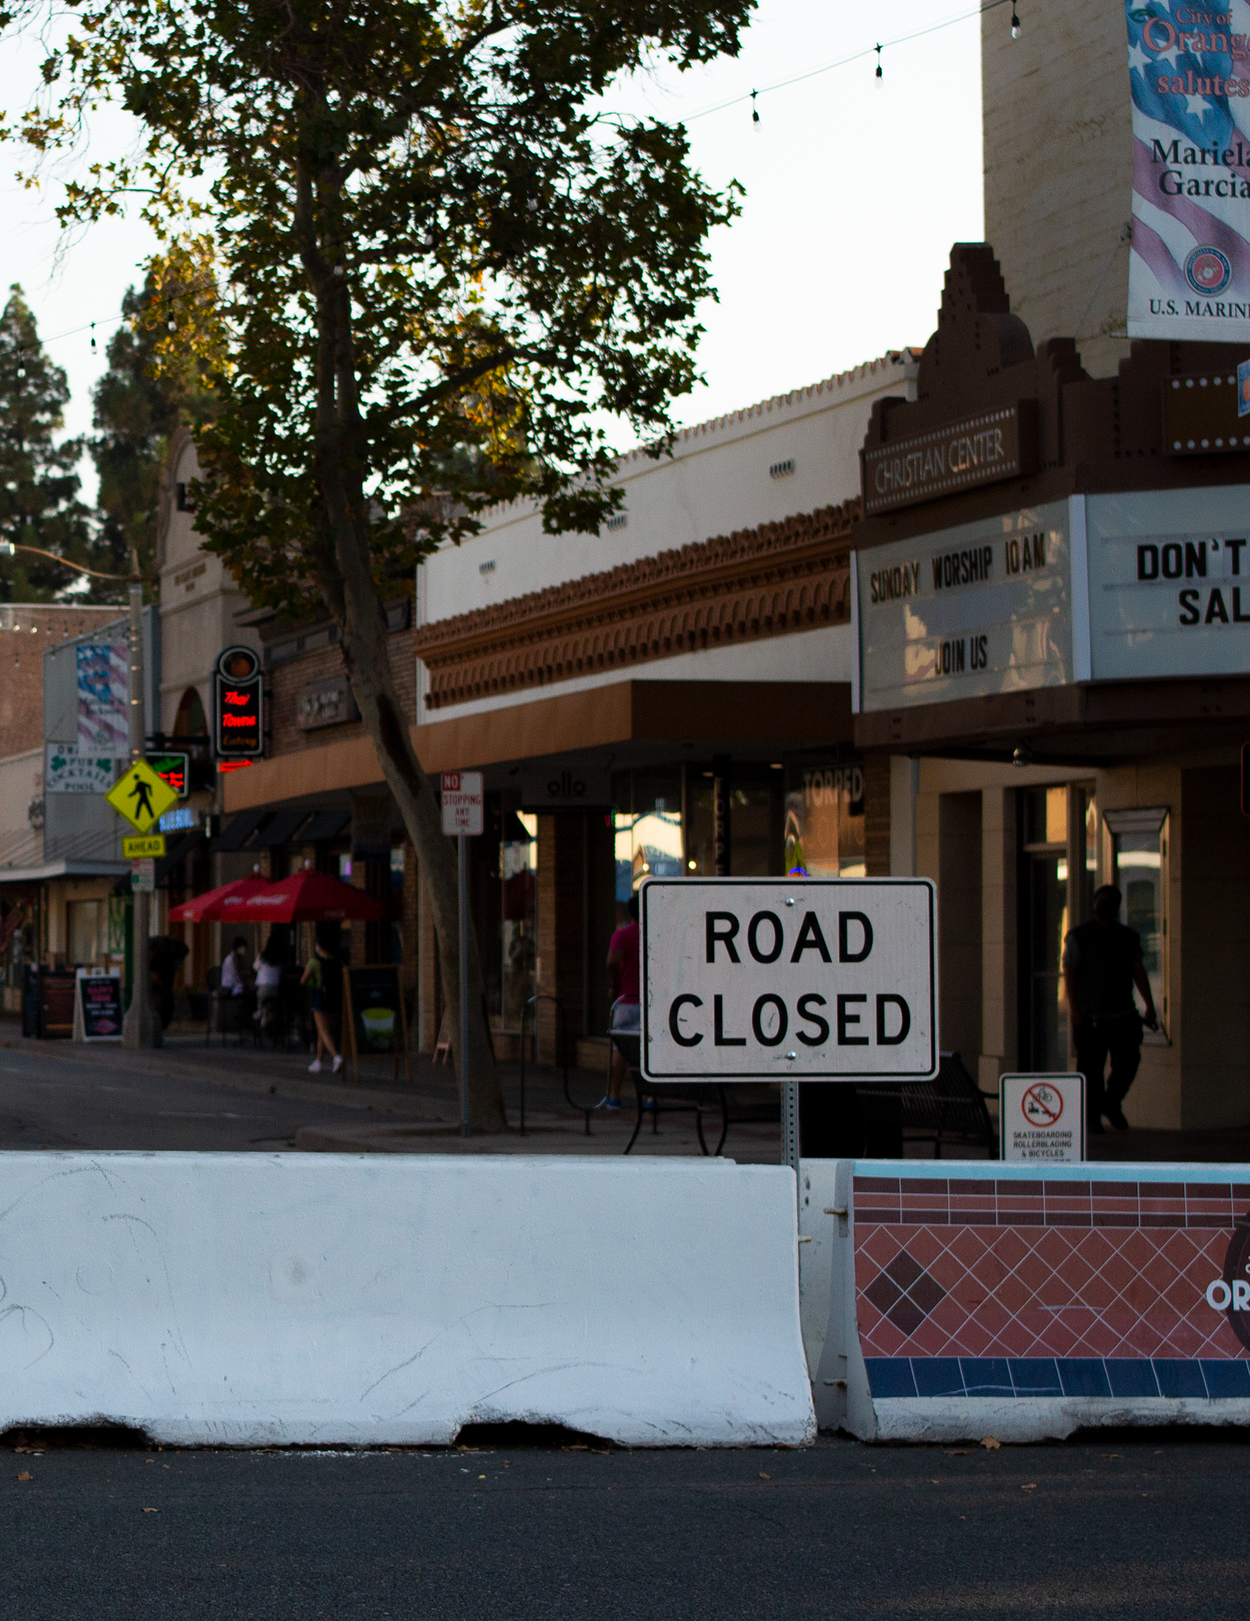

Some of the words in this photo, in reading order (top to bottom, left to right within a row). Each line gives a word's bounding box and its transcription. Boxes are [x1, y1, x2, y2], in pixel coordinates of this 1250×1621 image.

[1176, 7, 1212, 29] City
[1216, 8, 1233, 26] of
[1157, 69, 1250, 98] salutes
[1159, 170, 1250, 198] Garcia
[1149, 299, 1179, 316] U.S.
[875, 444, 945, 494] CHRISTIAN
[949, 428, 1005, 473] CENTER
[1137, 538, 1247, 581] DON'T
[870, 562, 919, 604] SUNDAY
[932, 546, 992, 590] WORSHIP
[935, 639, 965, 675] JOIN
[970, 635, 987, 670] US
[224, 690, 251, 706] Thai
[222, 713, 257, 728] Towne
[443, 775, 459, 789] NO
[547, 770, 586, 796] ollo
[443, 794, 481, 806] STOPPING
[454, 807, 470, 817] ANY
[454, 817, 470, 827] TIME
[128, 840, 160, 853] AHEAD
[705, 911, 873, 963] ROAD
[668, 993, 911, 1048] CLOSED
[1013, 1131, 1072, 1139] SKATEBOARDING
[1013, 1140, 1072, 1148] ROLLERBLADING
[1028, 1149, 1064, 1157] BICYCLES
